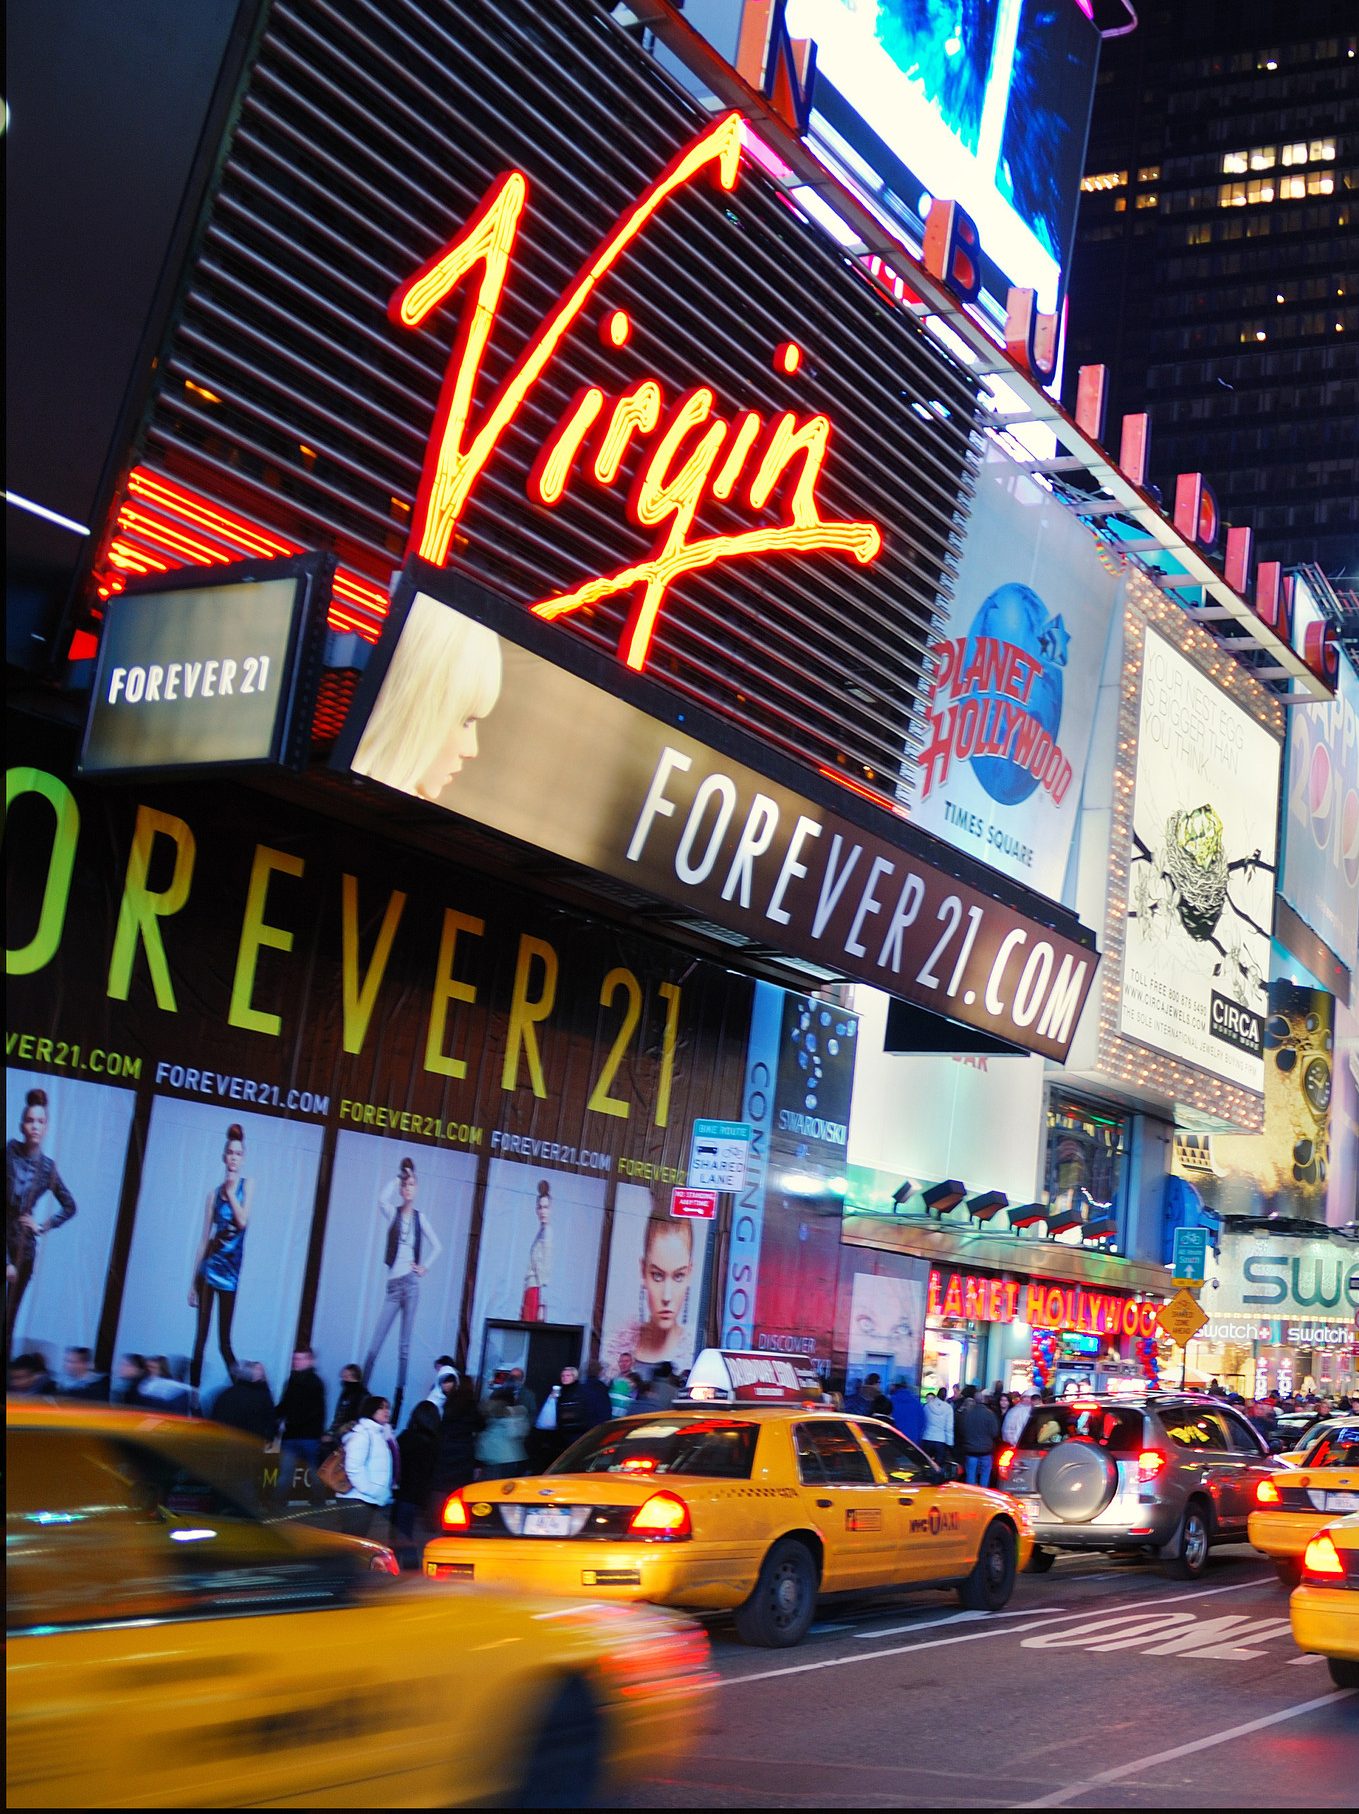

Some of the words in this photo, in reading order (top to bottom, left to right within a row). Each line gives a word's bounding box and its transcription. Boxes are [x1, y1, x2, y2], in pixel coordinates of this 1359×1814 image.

[388, 110, 882, 674] Virgin
[108, 657, 236, 705] FOREVER
[239, 654, 271, 695] 21
[926, 636, 1044, 720] PLANET
[1147, 645, 1184, 698] YOUR
[1186, 680, 1218, 727] NEST
[1220, 709, 1245, 751] EGG
[1142, 706, 1171, 751] YOU
[1158, 688, 1205, 742] BIGGER
[917, 694, 1074, 808] HOLLYWOOD
[945, 799, 985, 836] TIMES
[986, 824, 1035, 867] SQUARE
[1212, 999, 1260, 1043] CIRCA
[587, 966, 682, 1128] 21
[154, 1060, 330, 1116] FOREVER21.COM
[339, 1099, 483, 1147] FOREVER21.COM
[699, 1124, 719, 1134] BIKE
[719, 1126, 747, 1137] ROUTE
[778, 1109, 848, 1146] SWAROVSKI
[490, 1129, 612, 1171] FOREVER21.COM
[693, 1159, 745, 1173] SHARED
[732, 1060, 771, 1245] COMING
[700, 1174, 734, 1186] LANE
[758, 1333, 816, 1353] DISCOVER
[1288, 1325, 1348, 1344] swatch
[1021, 1612, 1294, 1662] ONL
